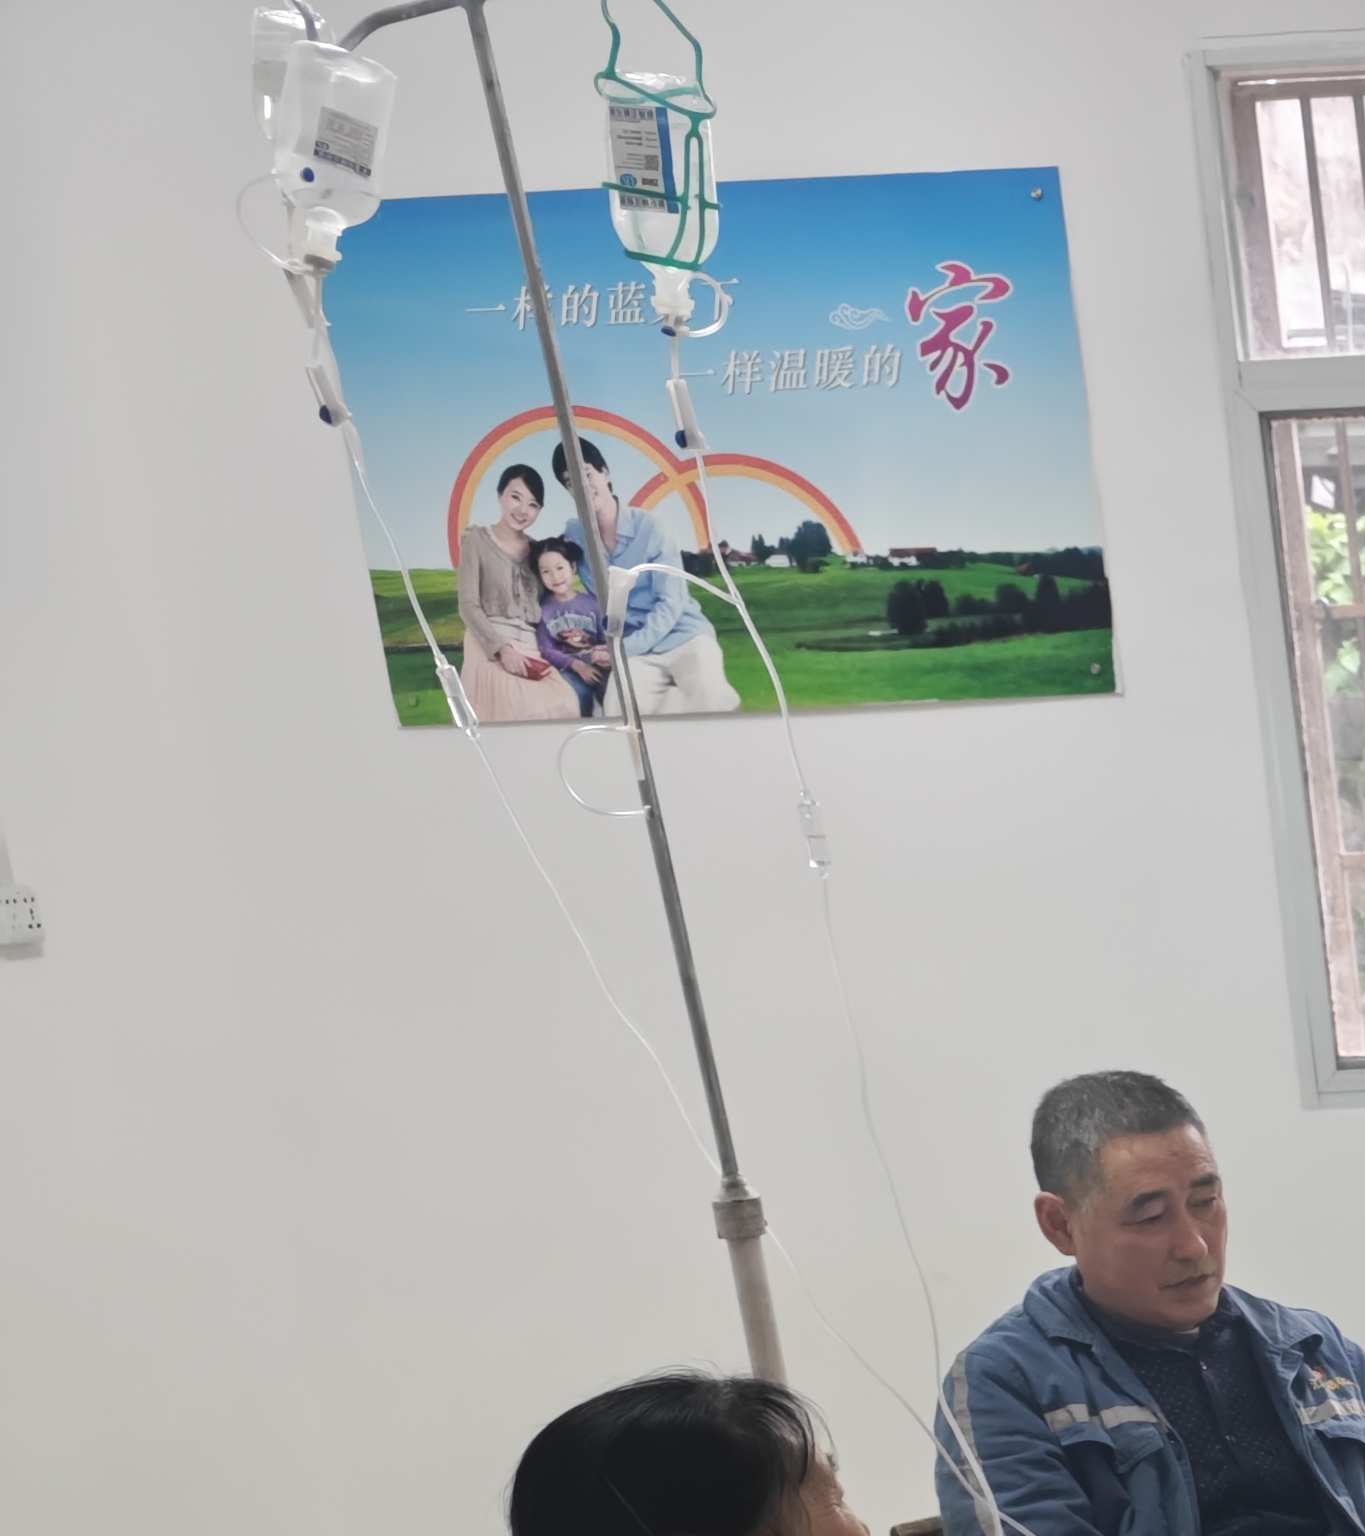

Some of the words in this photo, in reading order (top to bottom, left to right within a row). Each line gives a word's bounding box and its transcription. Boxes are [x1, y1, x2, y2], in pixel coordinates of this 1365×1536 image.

[464, 276, 740, 332] 一样的蓝下
[904, 260, 1016, 412] 家
